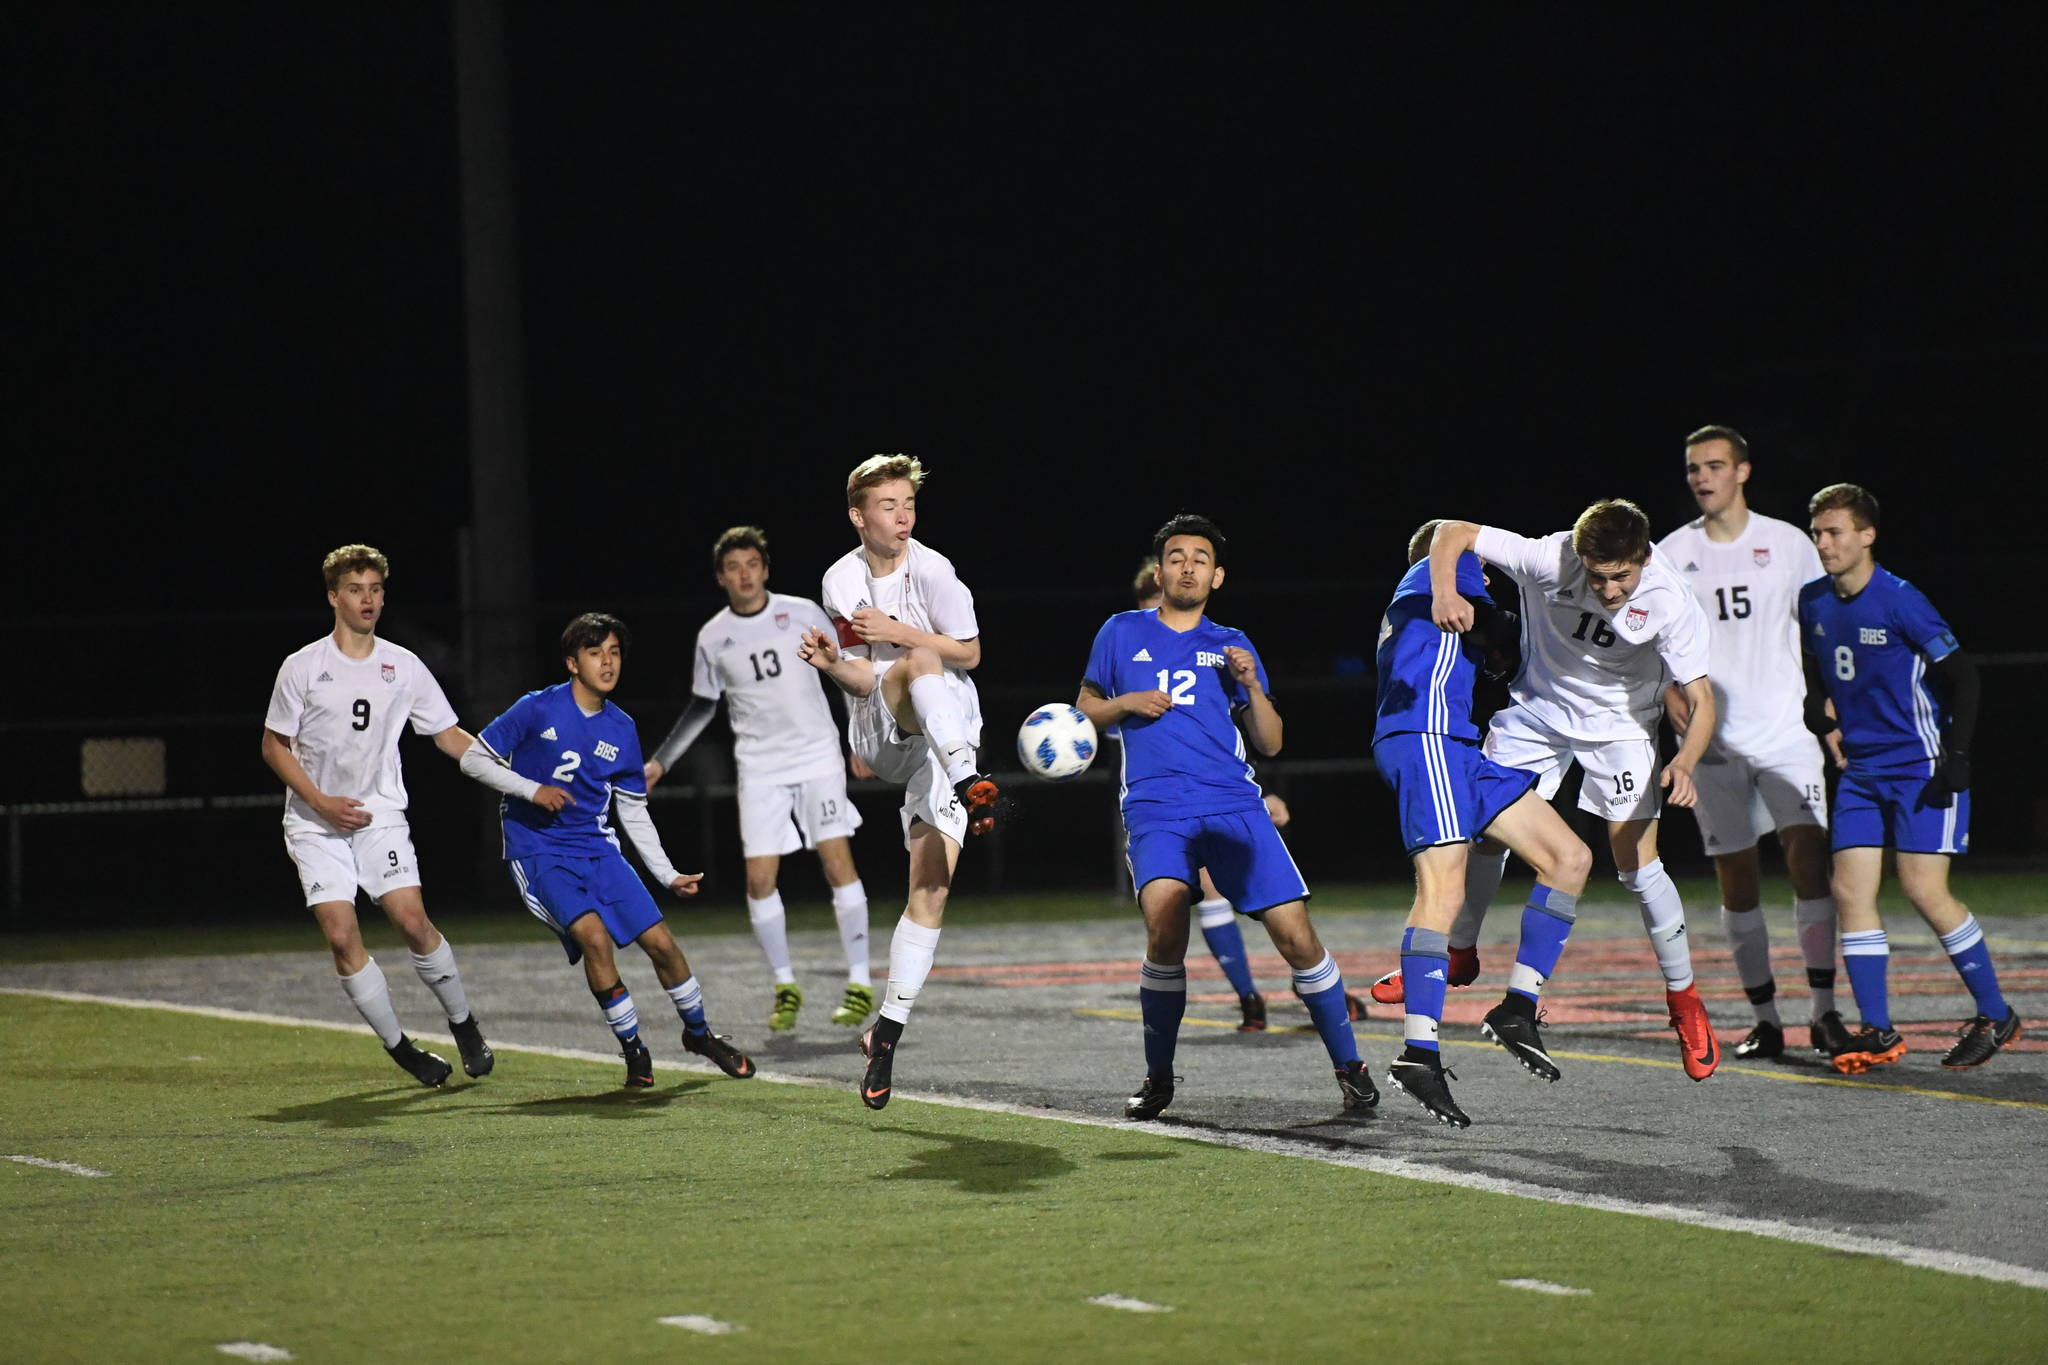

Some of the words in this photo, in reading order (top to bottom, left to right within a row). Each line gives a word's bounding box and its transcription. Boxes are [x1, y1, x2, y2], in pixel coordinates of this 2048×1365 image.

[1715, 585, 1752, 621] 15
[1572, 612, 1617, 648] 16
[1859, 627, 1888, 645] BHS
[750, 648, 782, 682] 13
[1196, 651, 1225, 668] BHS
[1834, 645, 1856, 681] 8
[1156, 669, 1197, 705] 12
[352, 698, 371, 731] 9
[593, 740, 620, 762] BHS
[552, 750, 581, 783] 2
[1613, 771, 1635, 795] 16
[1804, 784, 1821, 802] 15
[821, 799, 837, 817] 13
[1610, 794, 1632, 806] MOUNT
[388, 850, 399, 867] 9
